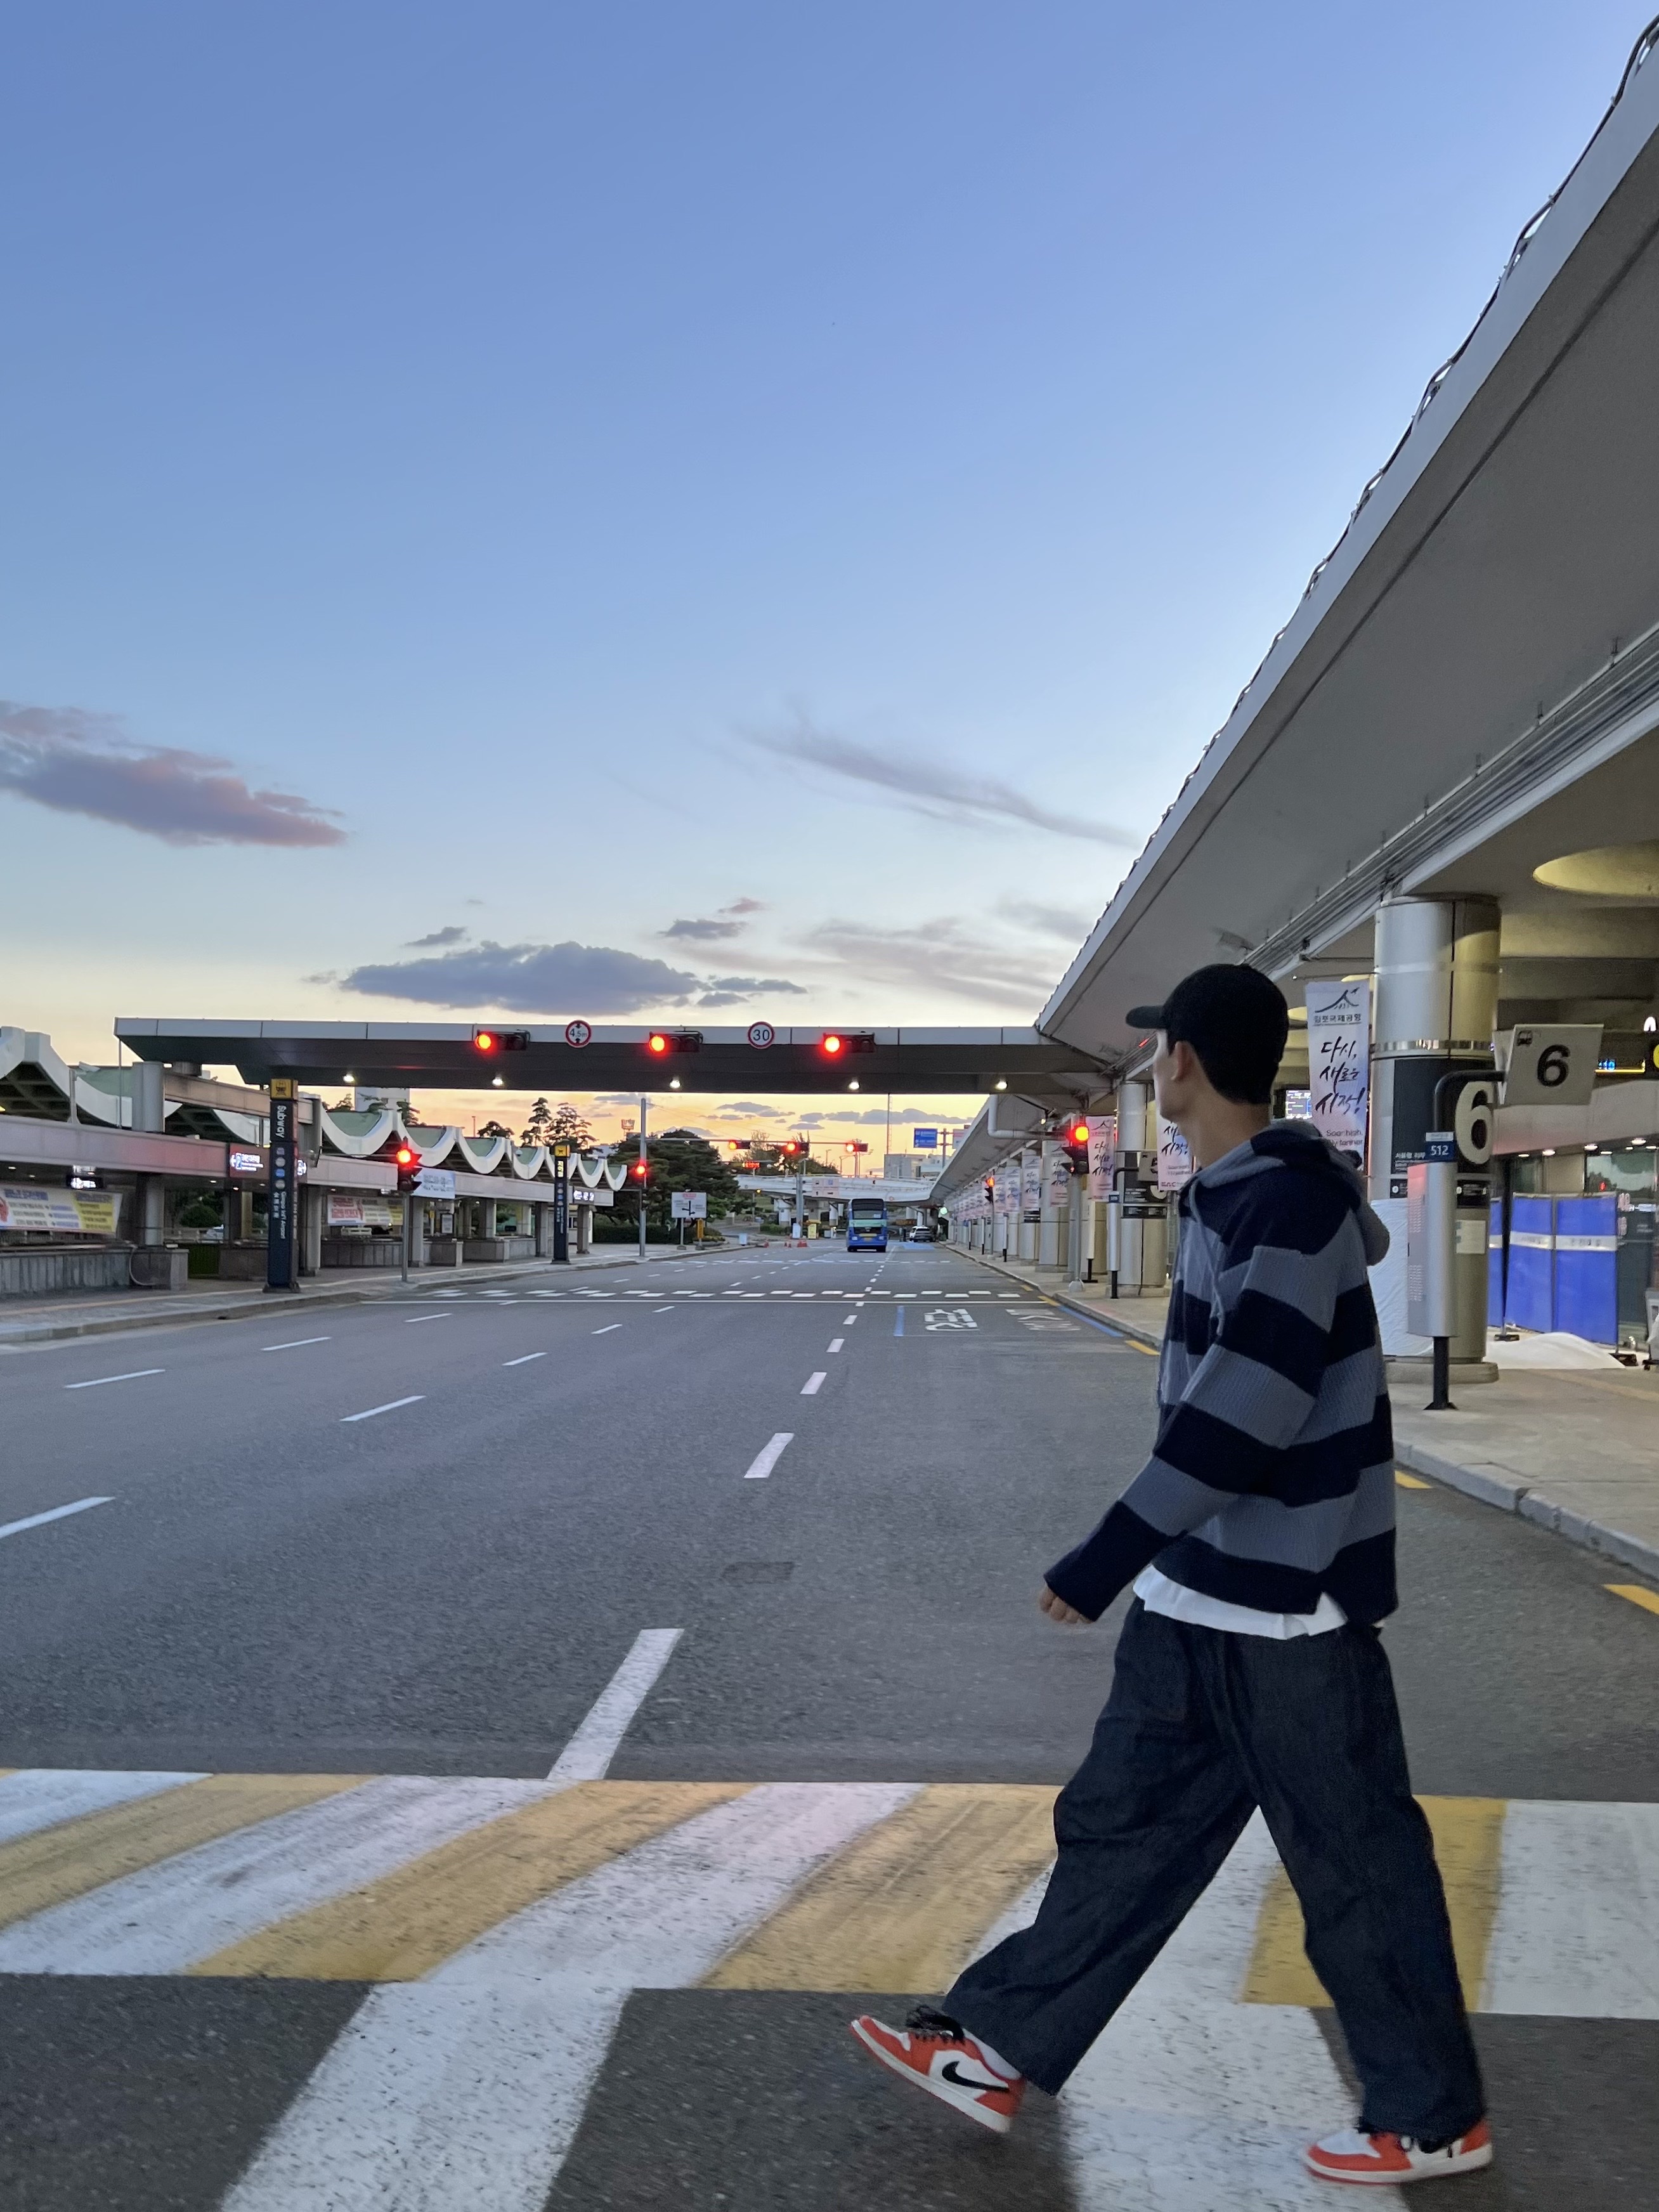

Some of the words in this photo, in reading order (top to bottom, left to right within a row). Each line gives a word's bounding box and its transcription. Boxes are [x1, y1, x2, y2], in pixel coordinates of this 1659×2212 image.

[569, 1028, 588, 1037] 4.5m
[753, 1029, 770, 1041] 30
[1321, 1036, 1356, 1063] 다시,
[1320, 1062, 1359, 1093] 새로운
[1537, 1044, 1571, 1087] 6
[1315, 1087, 1365, 1115] 시작!
[276, 1105, 287, 1138] Subway
[1455, 1081, 1493, 1164] 6
[1430, 1145, 1449, 1155] 512
